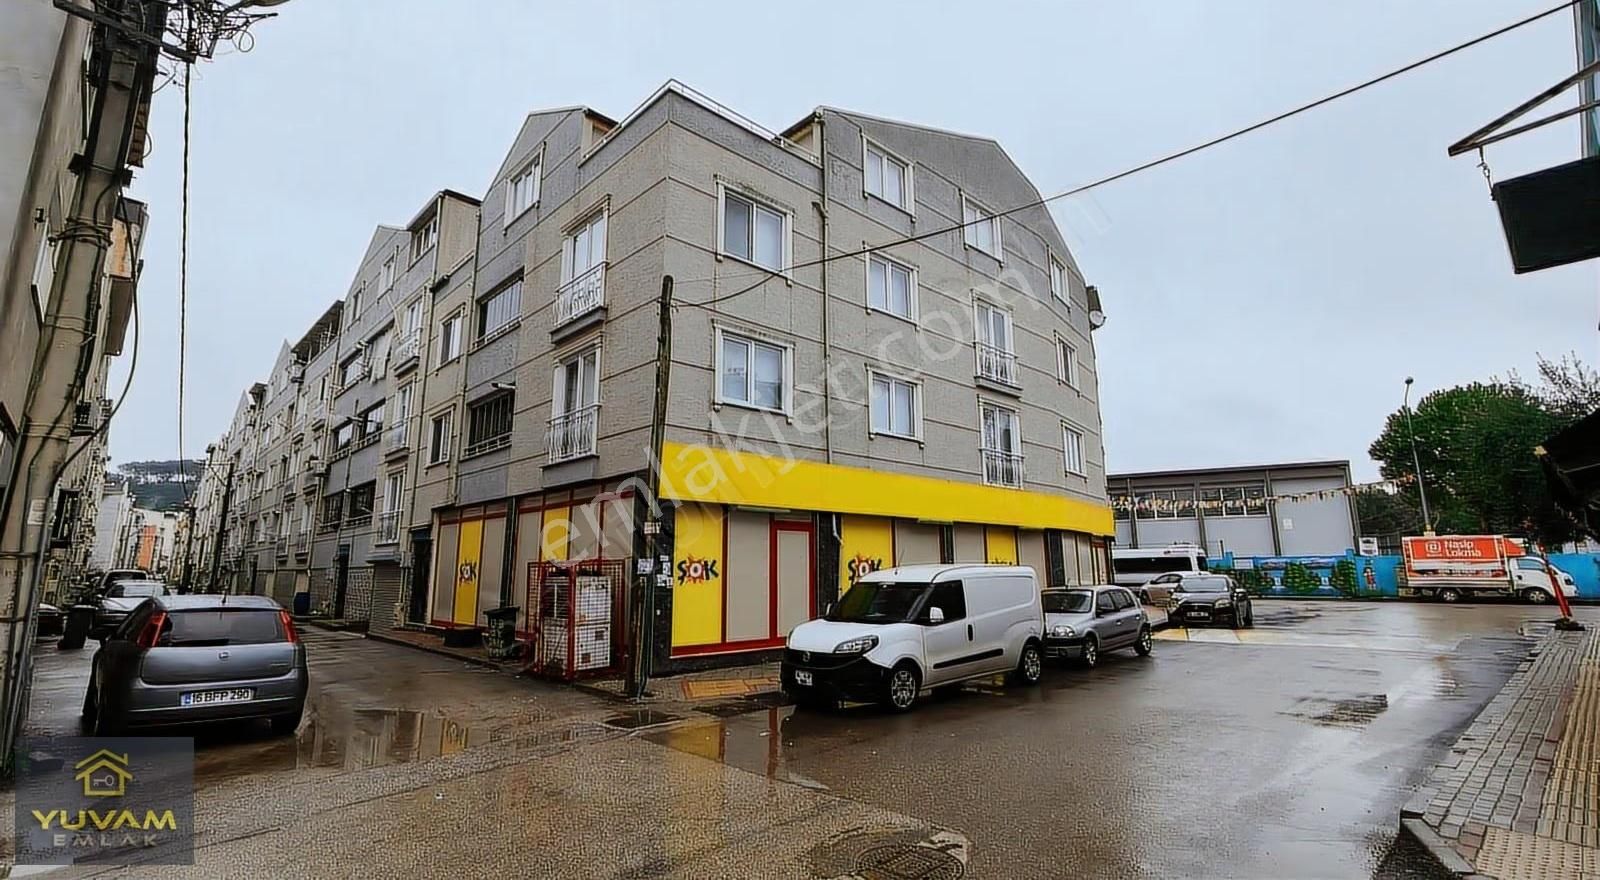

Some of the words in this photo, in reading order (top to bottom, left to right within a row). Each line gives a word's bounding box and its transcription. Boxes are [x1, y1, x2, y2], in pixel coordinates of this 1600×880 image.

[193, 693, 203, 703] 16
[204, 690, 229, 702] BFP
[230, 688, 250, 700] 290
